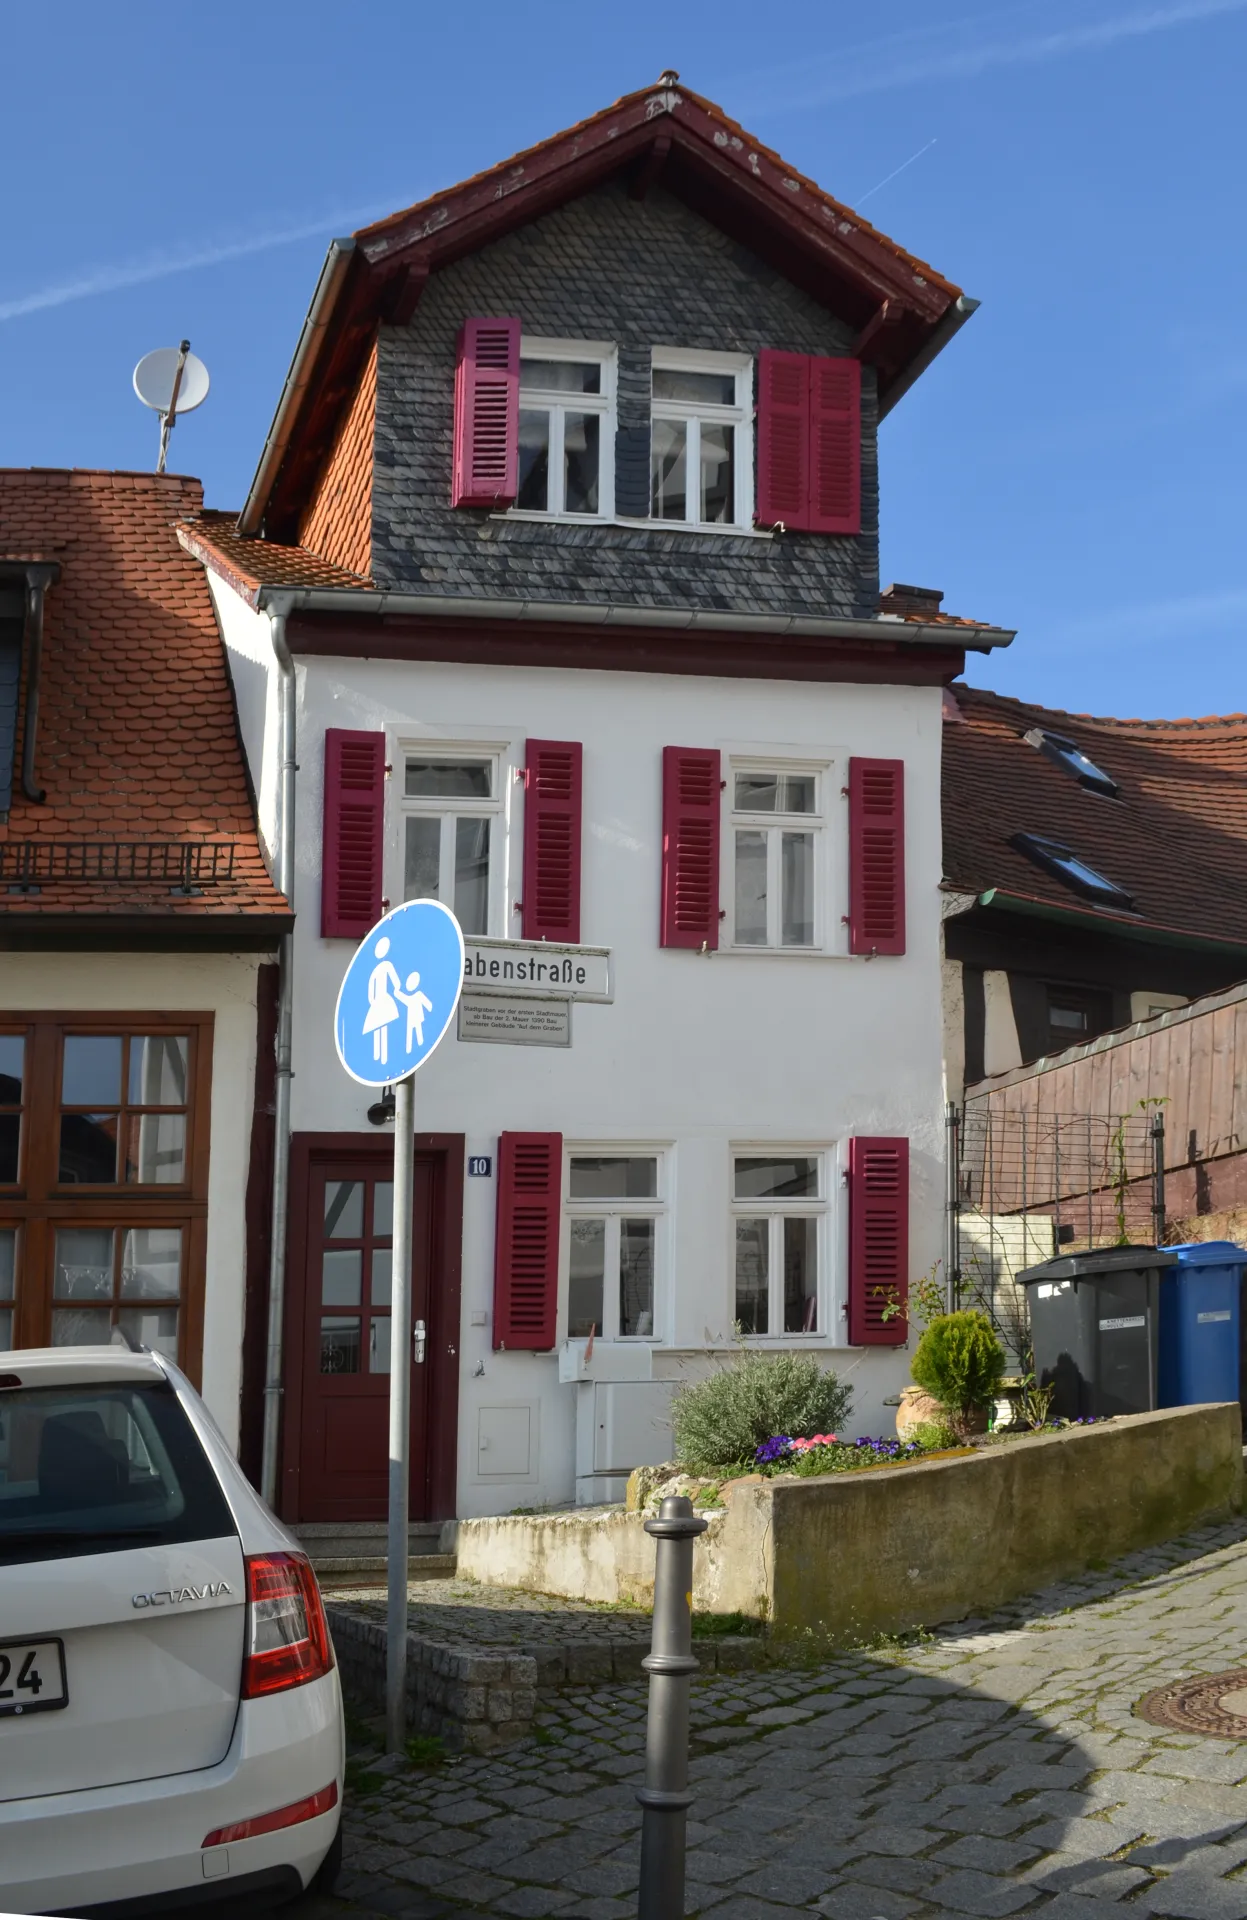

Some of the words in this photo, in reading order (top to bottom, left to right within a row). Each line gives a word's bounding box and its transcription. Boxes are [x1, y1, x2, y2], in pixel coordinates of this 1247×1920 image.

[464, 952, 586, 984] abenstraße
[463, 1005, 496, 1014] Stadtgraben
[490, 1021, 515, 1029] Gebäude
[472, 1159, 487, 1174] 10
[131, 1581, 233, 1609] OCTAVIA
